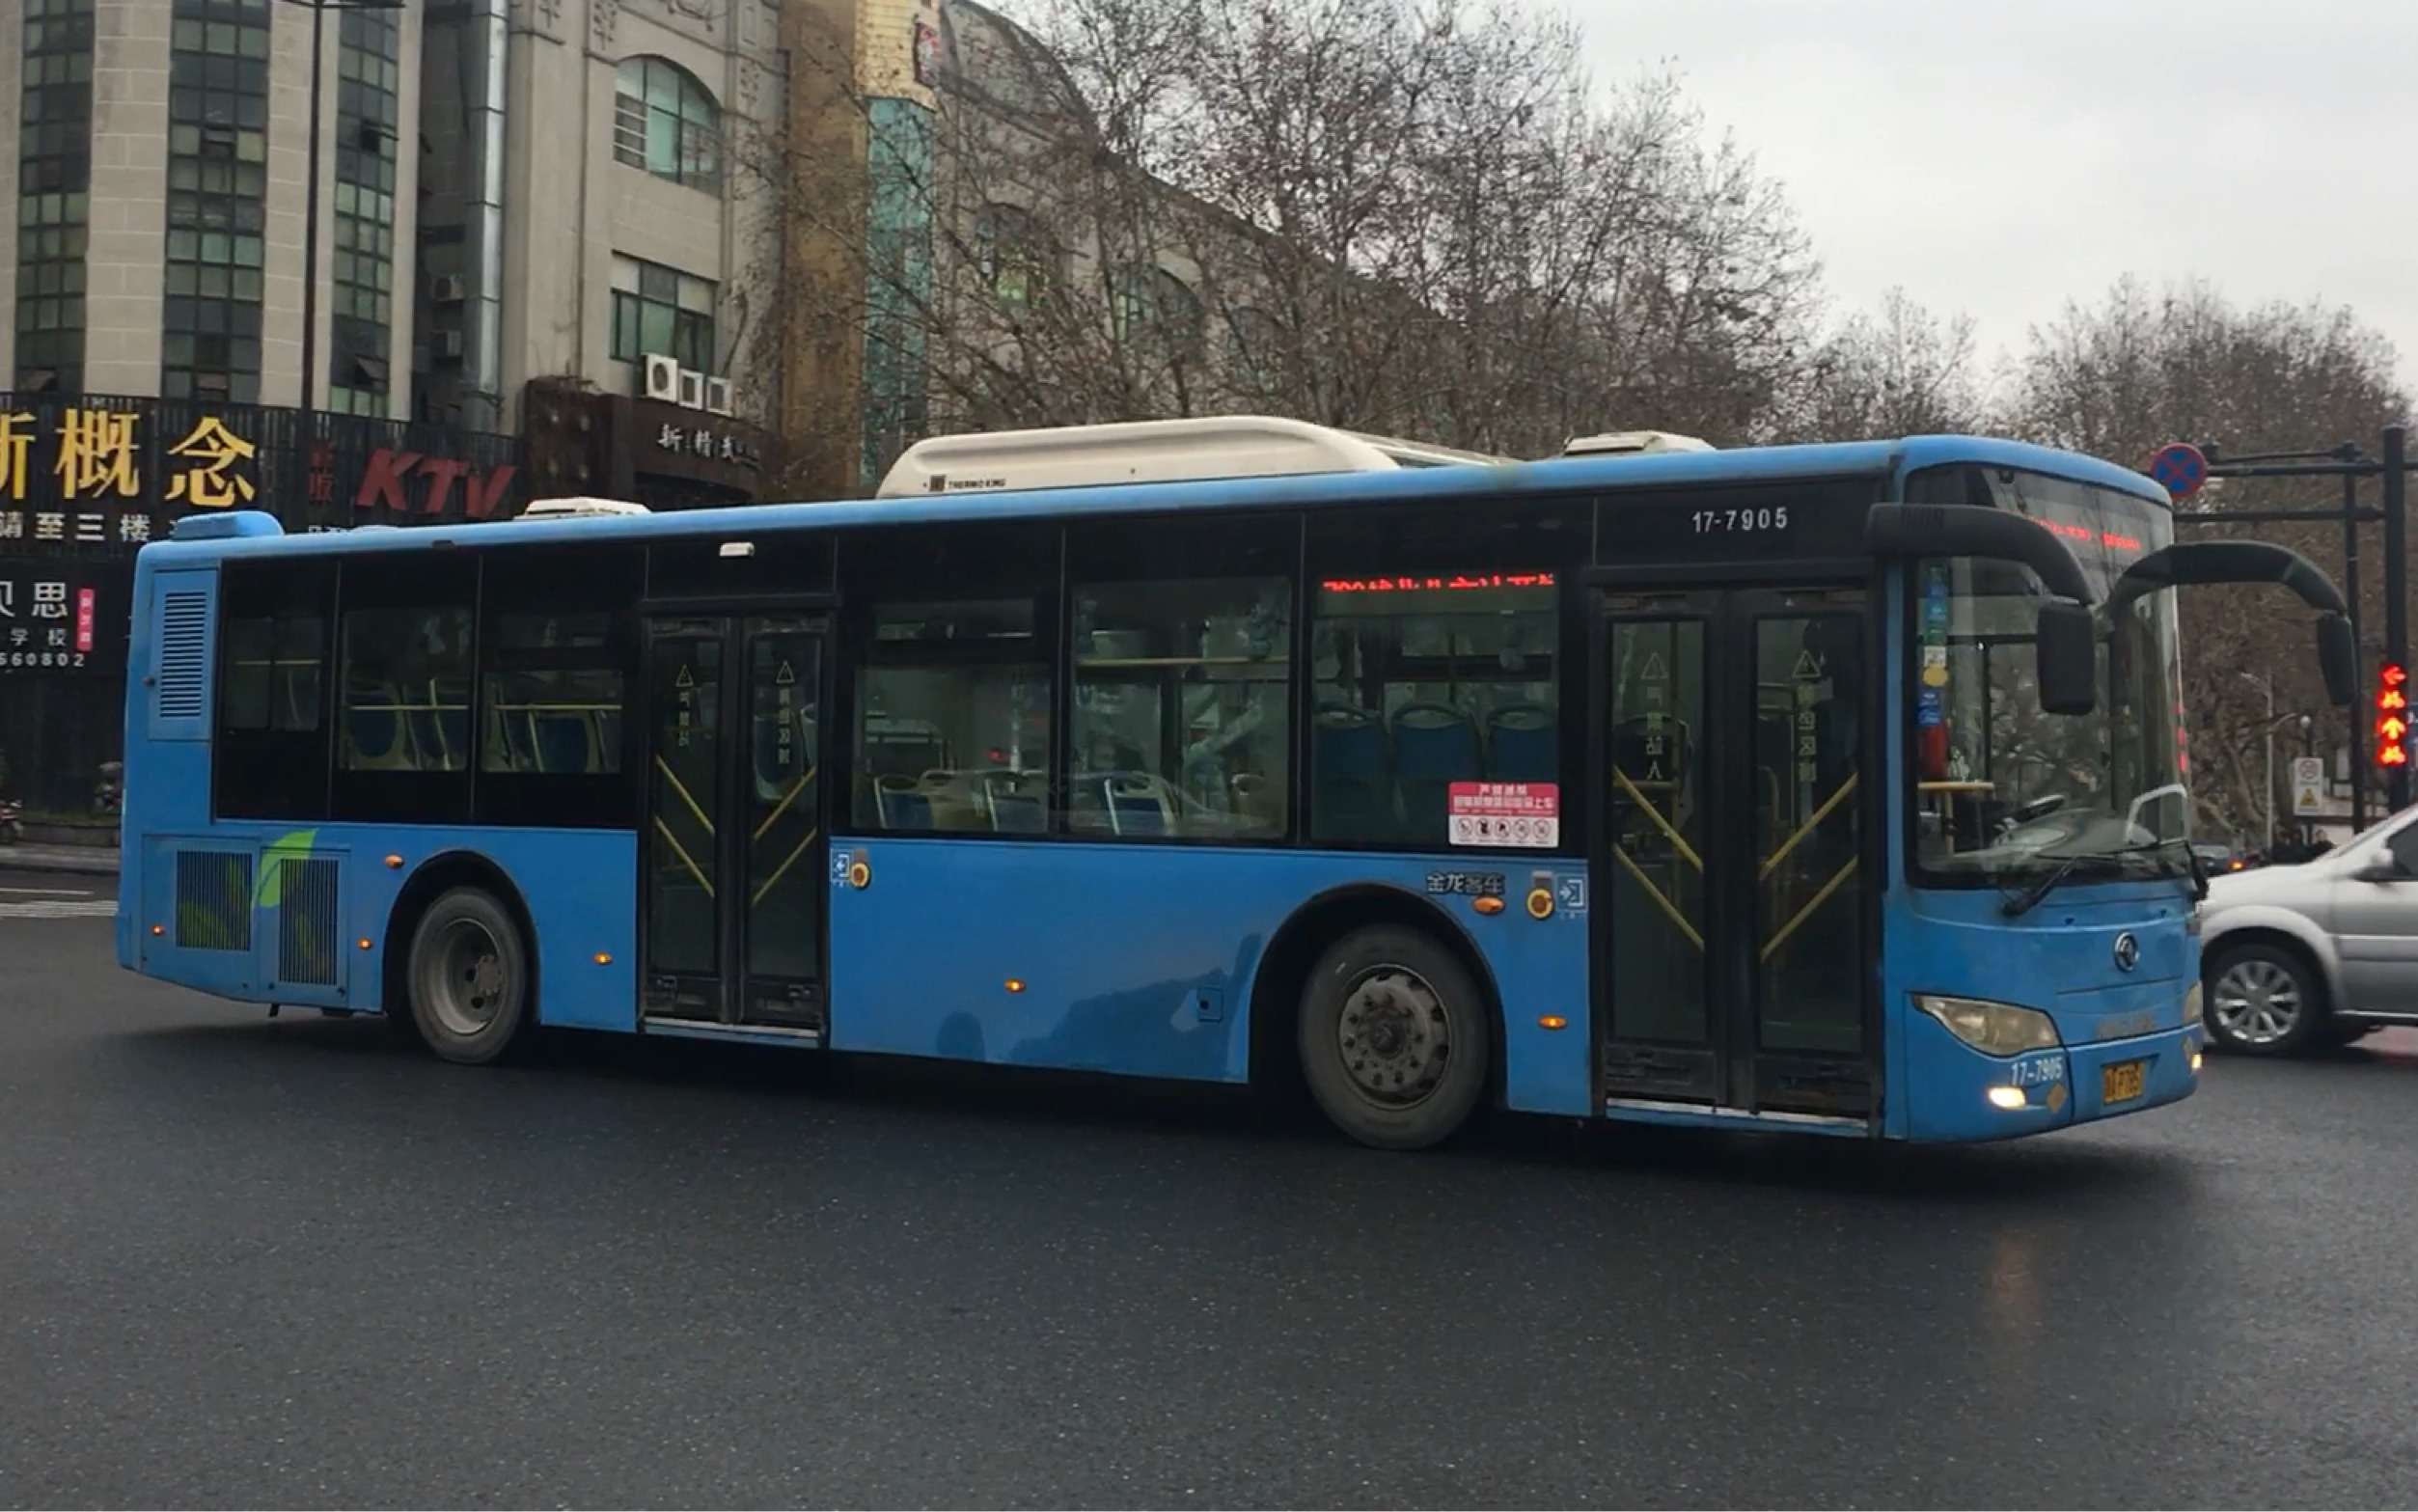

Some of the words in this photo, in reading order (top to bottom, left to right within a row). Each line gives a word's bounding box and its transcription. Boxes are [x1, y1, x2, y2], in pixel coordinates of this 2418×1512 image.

[355, 448, 518, 518] KTV
[0, 511, 178, 542] 请至三楼
[1692, 507, 1788, 533] 17-7905
[11, 628, 67, 646] 学校
[2011, 1058, 2063, 1086] 17-7905
